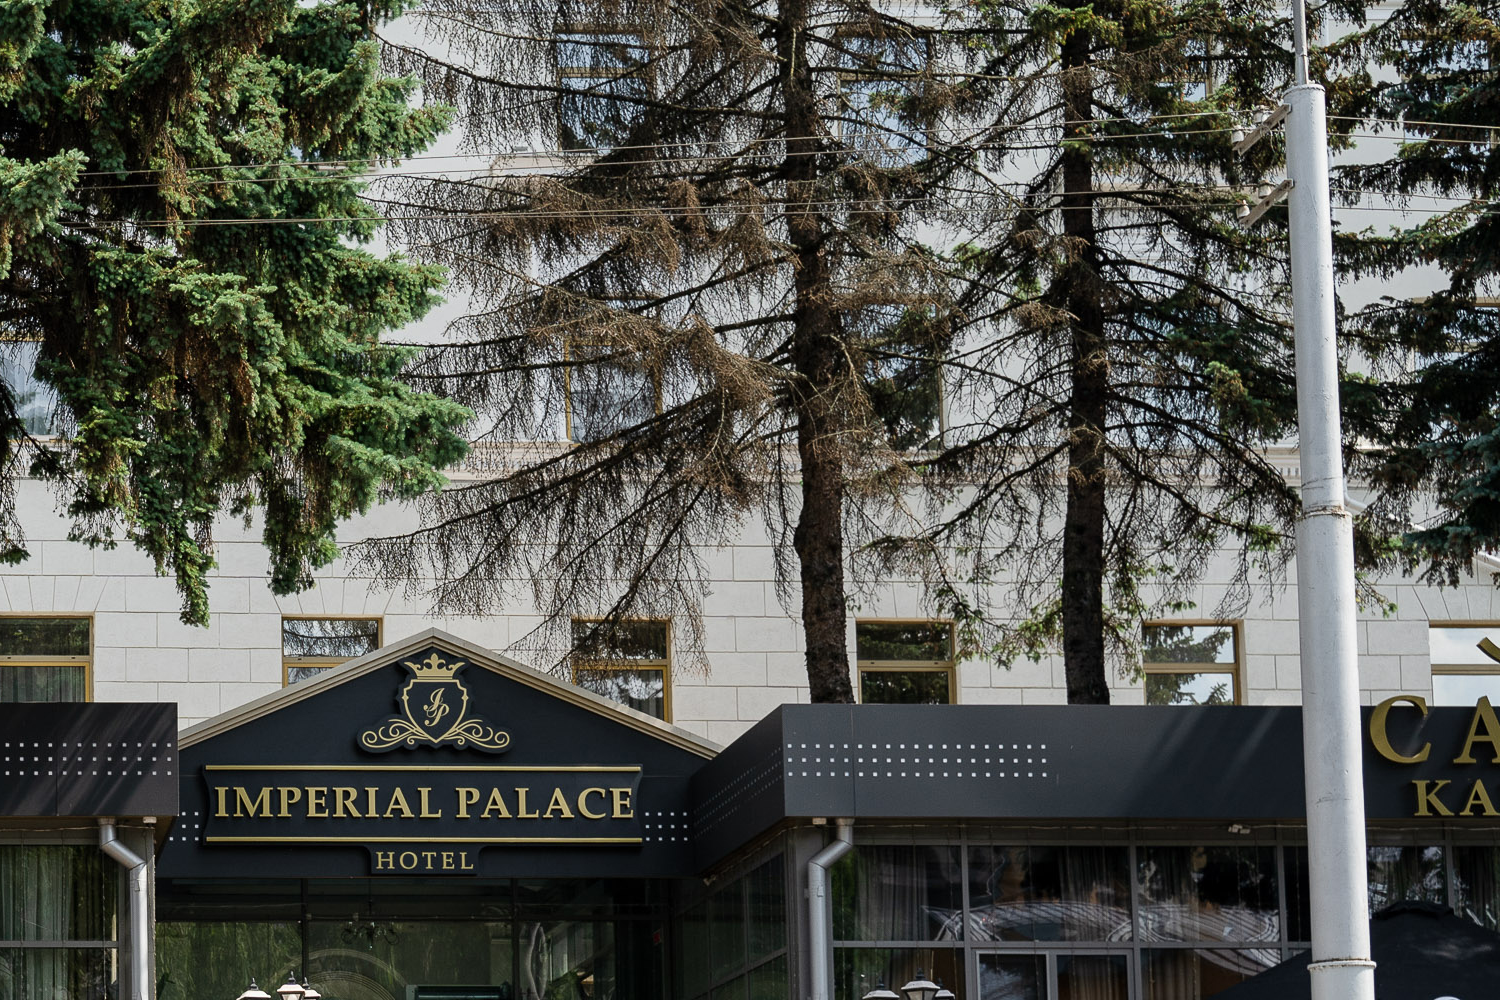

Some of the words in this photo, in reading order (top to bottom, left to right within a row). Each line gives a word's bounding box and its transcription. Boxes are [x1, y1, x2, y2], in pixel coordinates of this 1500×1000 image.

[214, 786, 442, 819] IMPERIAL
[455, 786, 635, 820] PALACE
[375, 851, 474, 870] HOTEL
